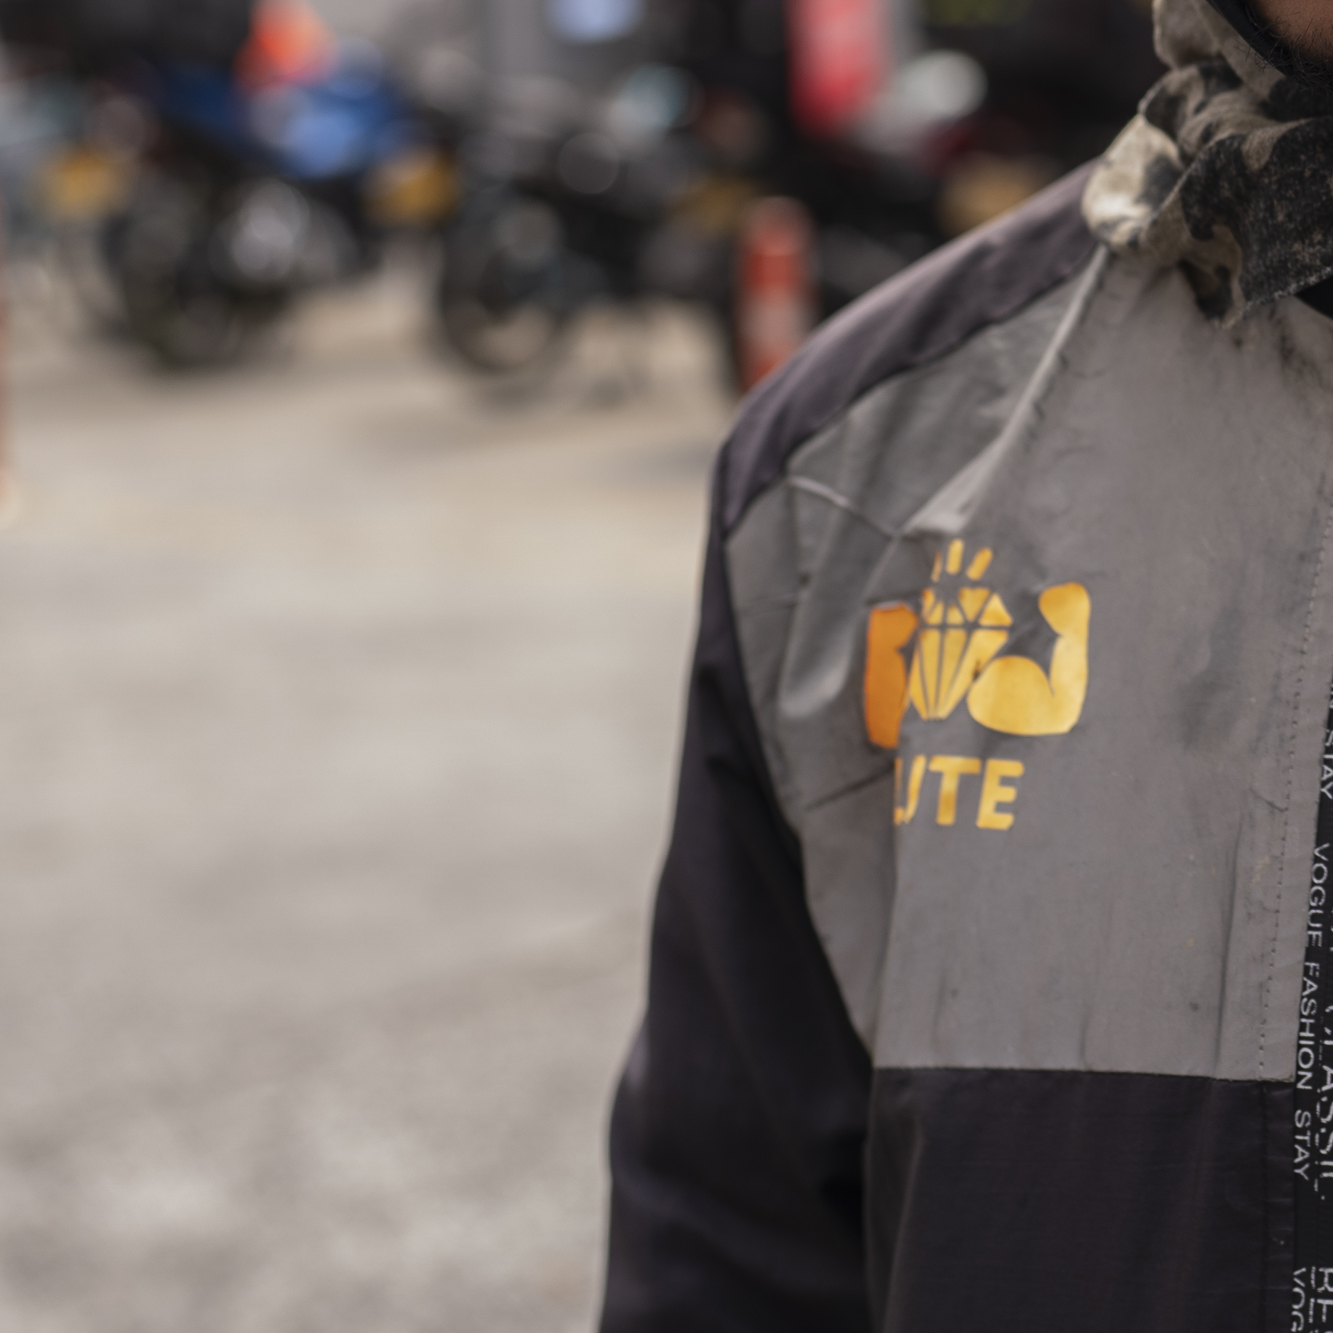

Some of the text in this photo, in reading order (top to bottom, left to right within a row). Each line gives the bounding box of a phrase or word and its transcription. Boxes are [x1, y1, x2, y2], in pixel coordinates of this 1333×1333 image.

[1293, 842, 1331, 1181] VOGUE FASHION STAY
